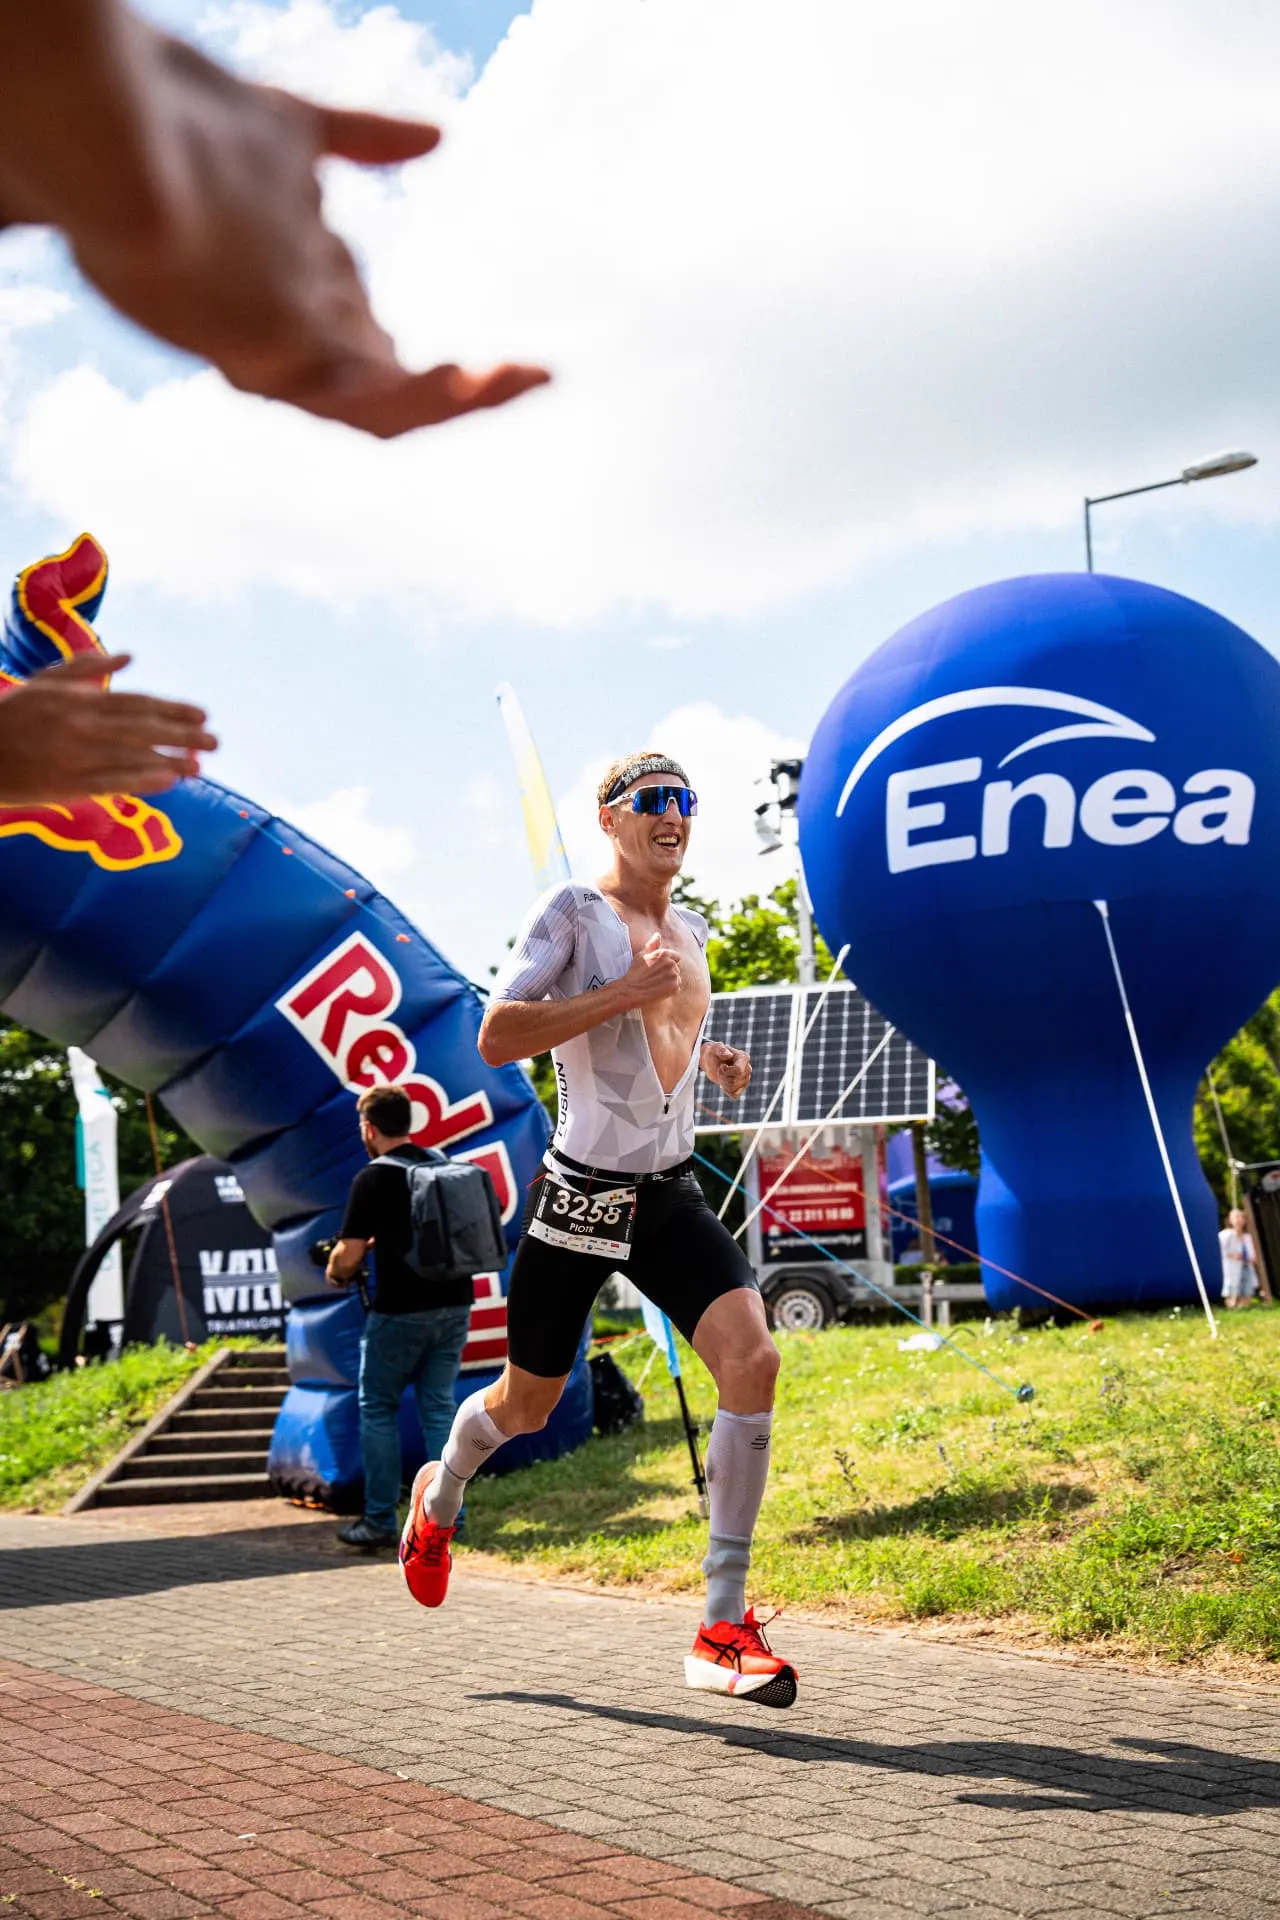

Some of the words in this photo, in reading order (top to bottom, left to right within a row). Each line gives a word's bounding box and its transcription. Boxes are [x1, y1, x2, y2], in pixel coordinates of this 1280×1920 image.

[886, 756, 1256, 875] Enea
[282, 936, 491, 1148] Red
[552, 1189, 622, 1225] 3258
[569, 1222, 595, 1234] PIOTR
